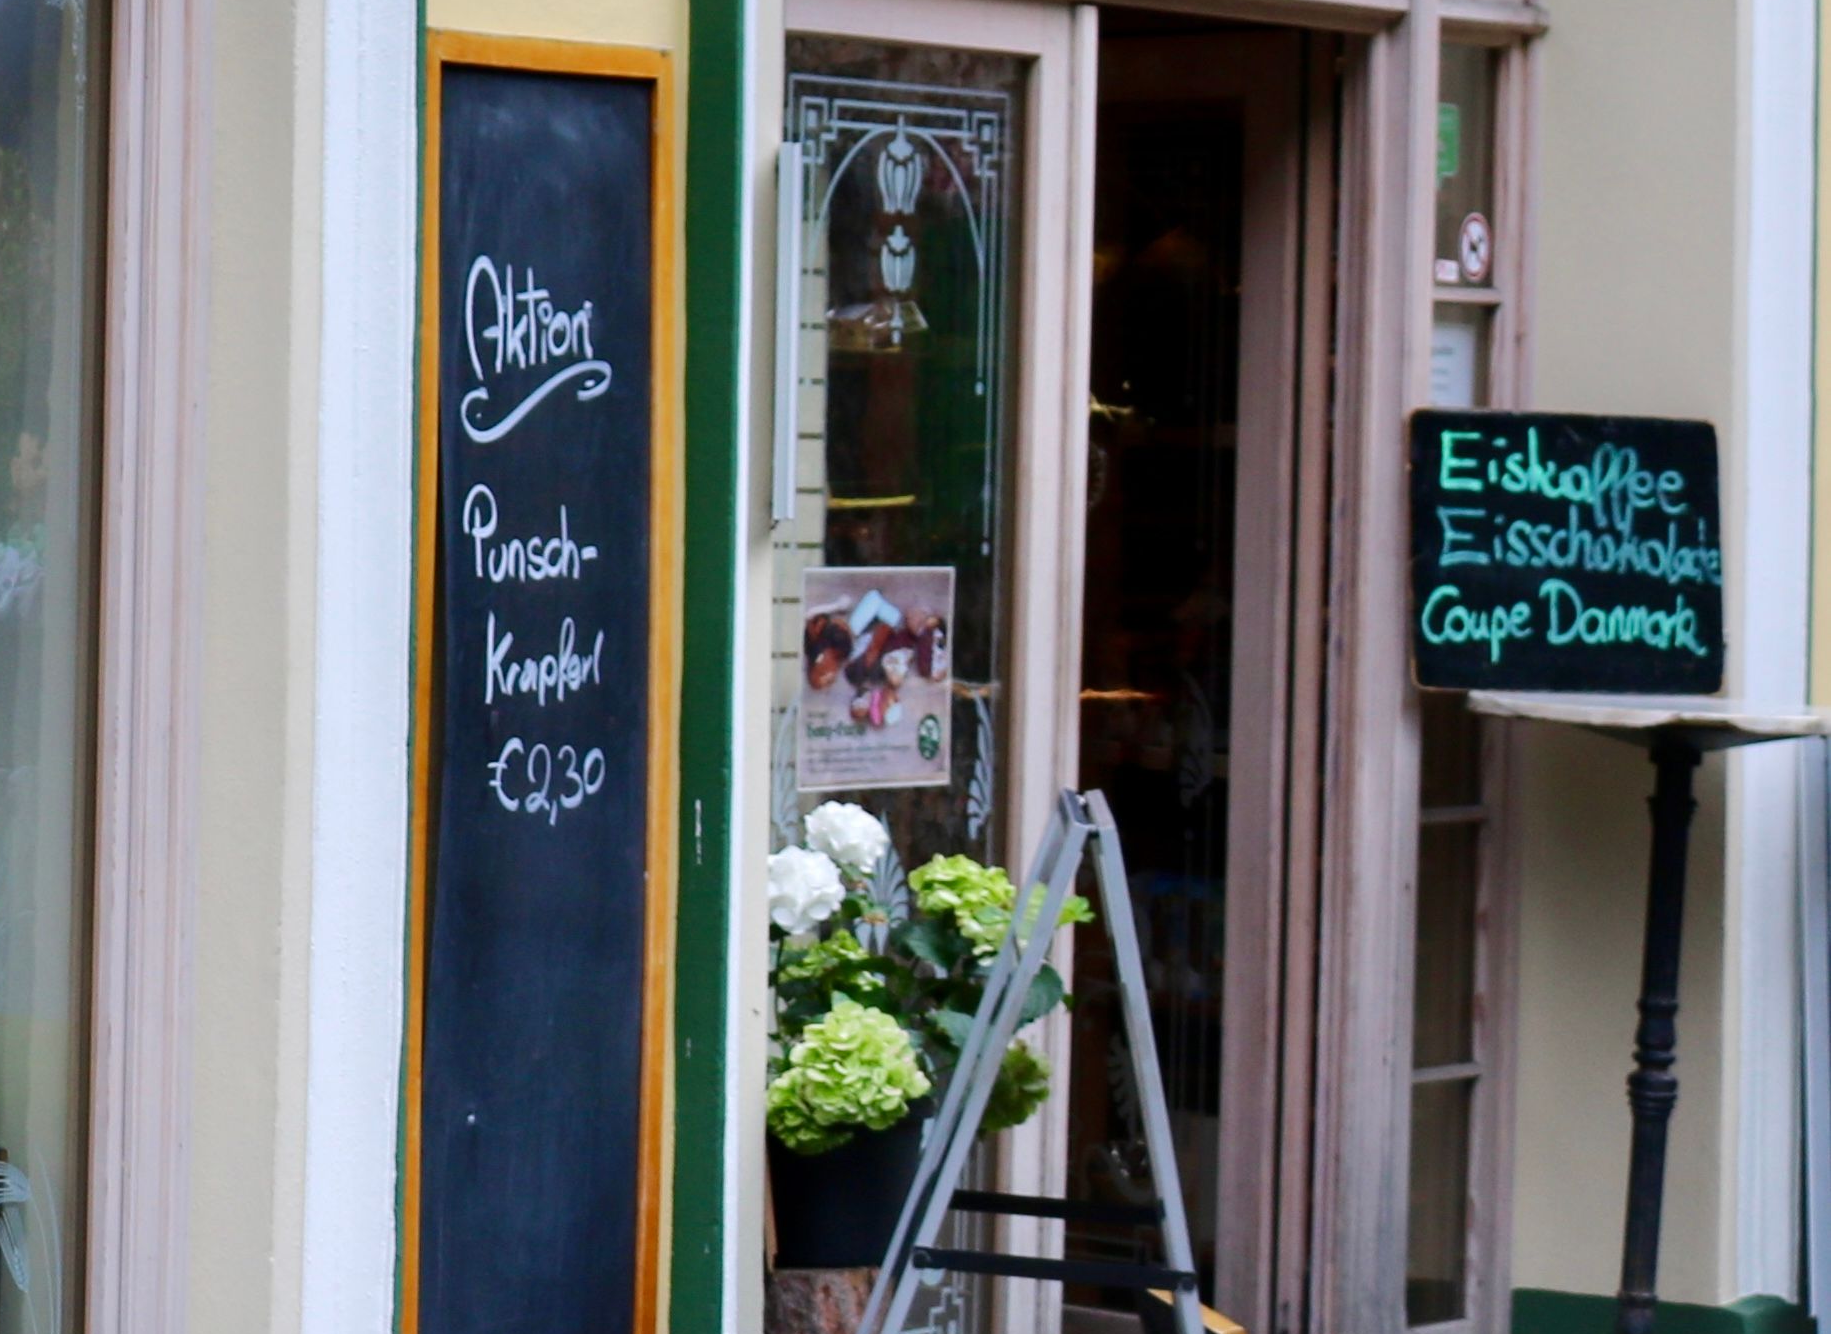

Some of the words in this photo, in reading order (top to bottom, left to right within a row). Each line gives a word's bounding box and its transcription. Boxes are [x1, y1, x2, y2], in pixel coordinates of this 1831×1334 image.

[464, 254, 595, 381] Aktion
[1440, 425, 1689, 531] Eiskaffee
[462, 483, 598, 583] Punsch-
[1421, 585, 1534, 665] Coupe
[1539, 578, 1709, 657] Danmark
